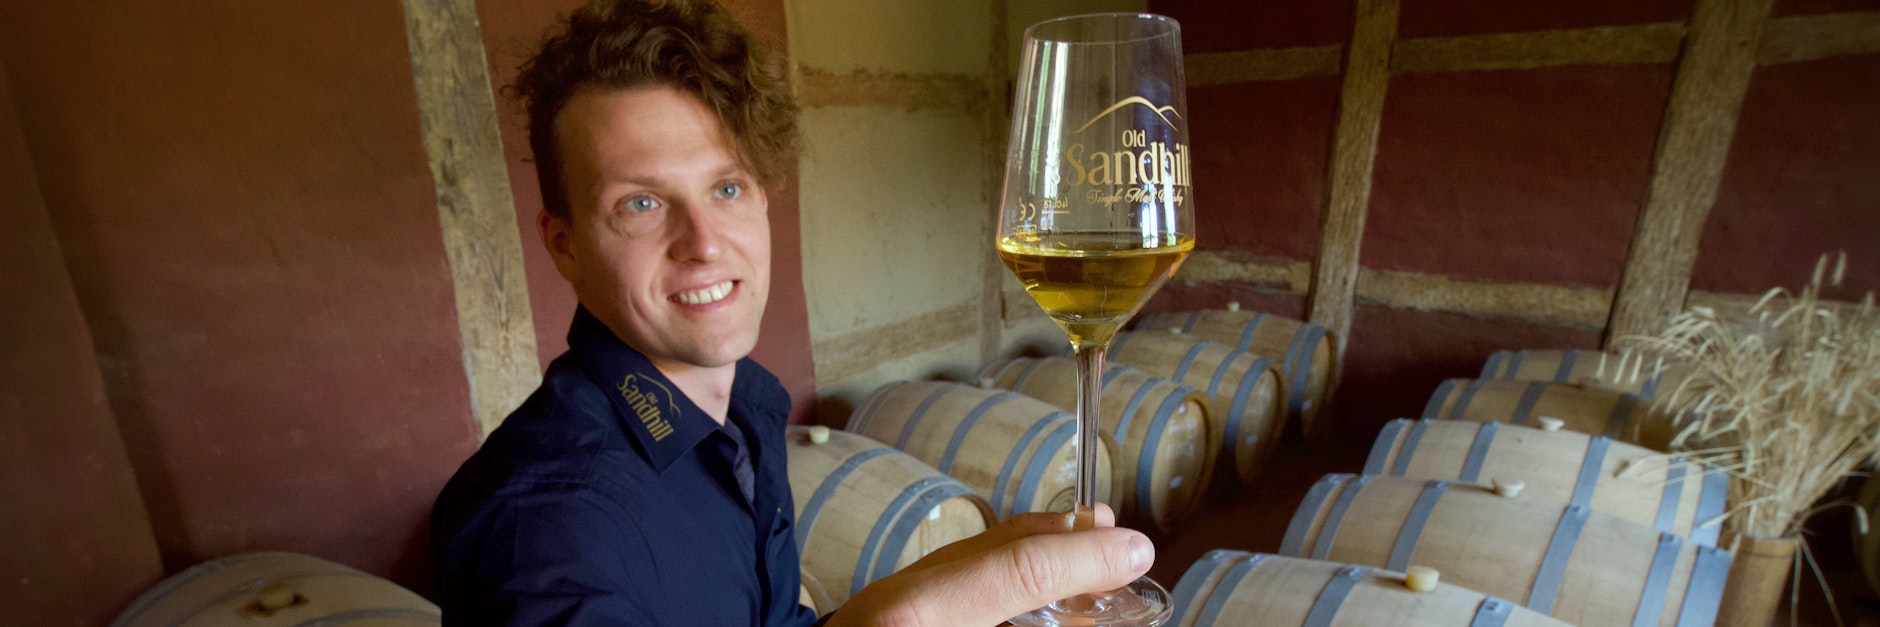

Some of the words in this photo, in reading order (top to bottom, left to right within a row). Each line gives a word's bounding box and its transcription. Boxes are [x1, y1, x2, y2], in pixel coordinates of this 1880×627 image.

[1122, 130, 1146, 148] Old
[1066, 141, 1190, 187] Sandhill
[1087, 188, 1123, 208] Single
[616, 374, 674, 442] Sandhill
